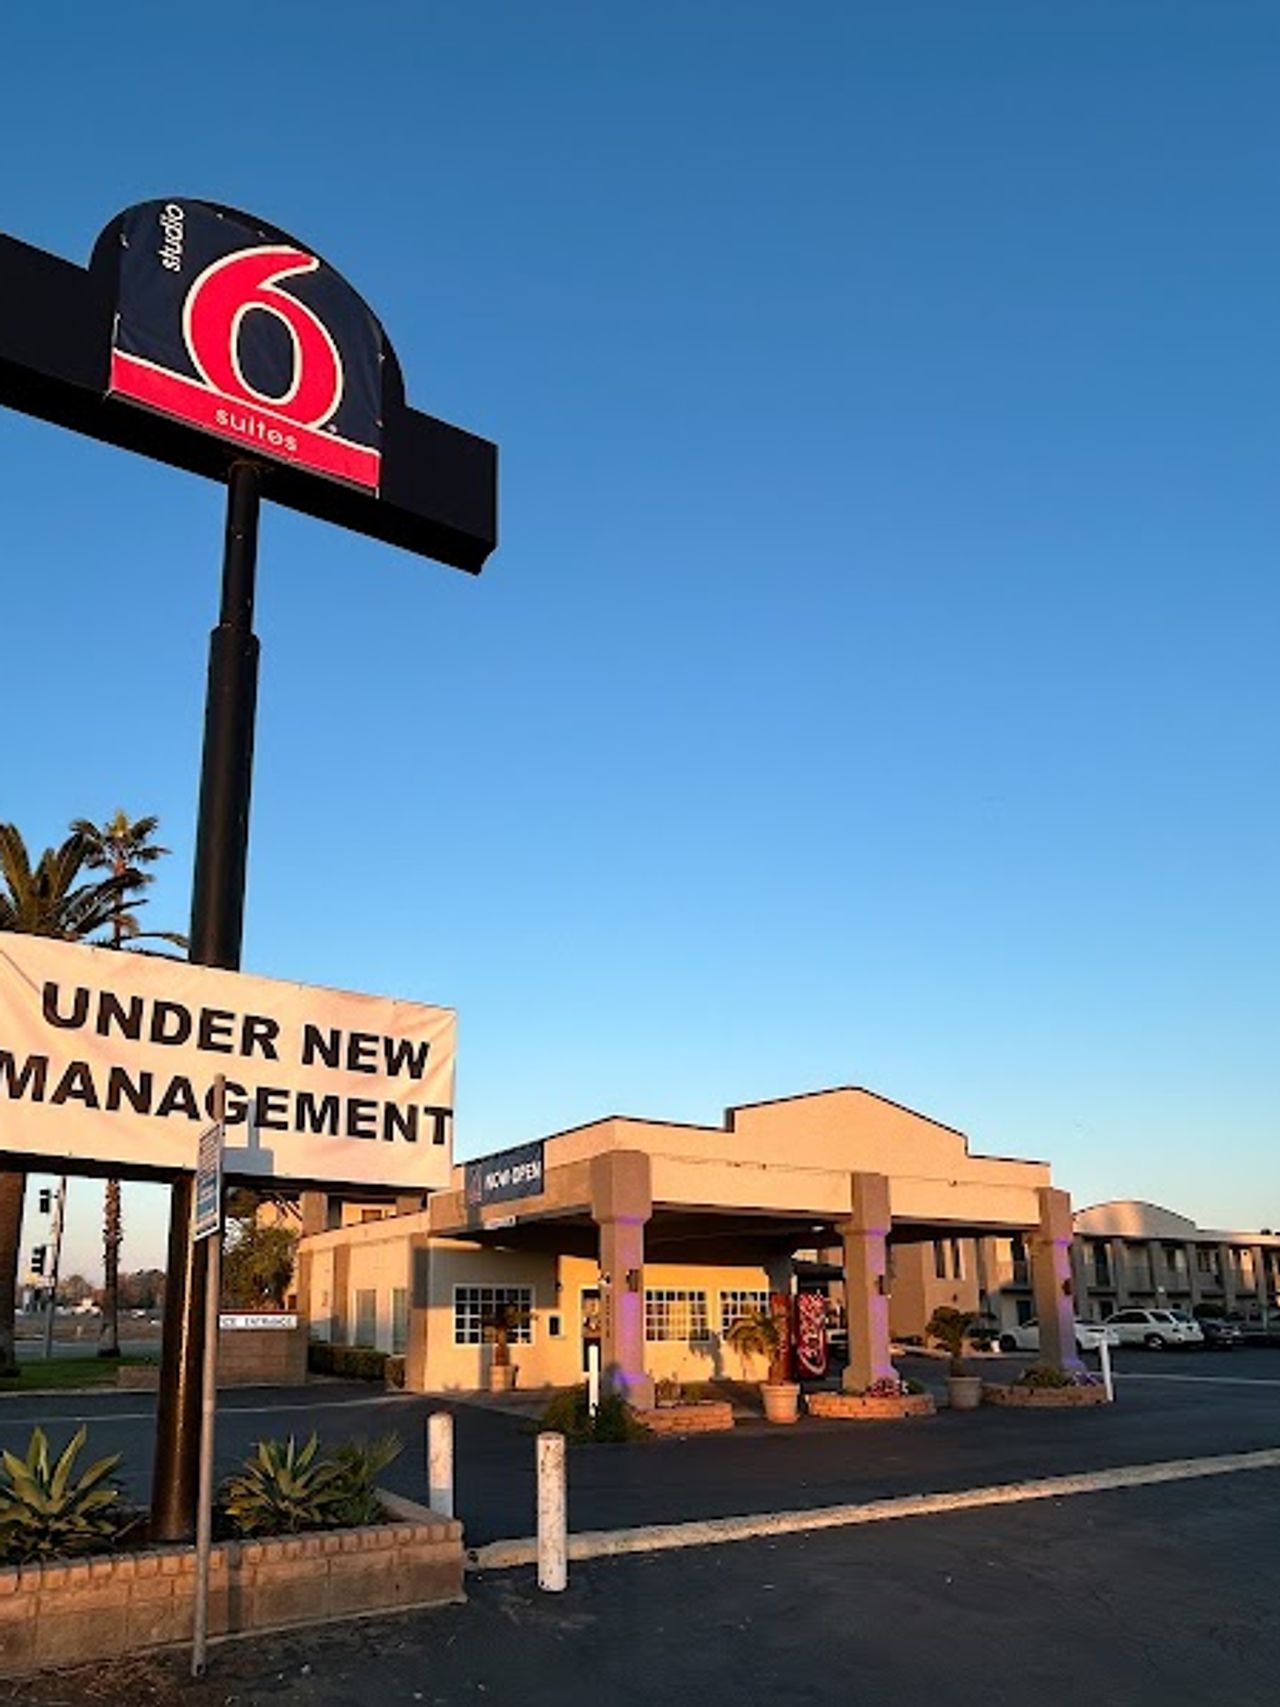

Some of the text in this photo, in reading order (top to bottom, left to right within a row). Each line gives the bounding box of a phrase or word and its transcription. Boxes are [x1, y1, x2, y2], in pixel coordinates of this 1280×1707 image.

[159, 203, 184, 272] studio
[182, 244, 343, 429] 6
[215, 408, 298, 451] suites
[42, 981, 430, 1080] UNDER NEW
[0, 1050, 454, 1146] MANAGEMENT
[484, 1160, 542, 1191] NOW OPEN
